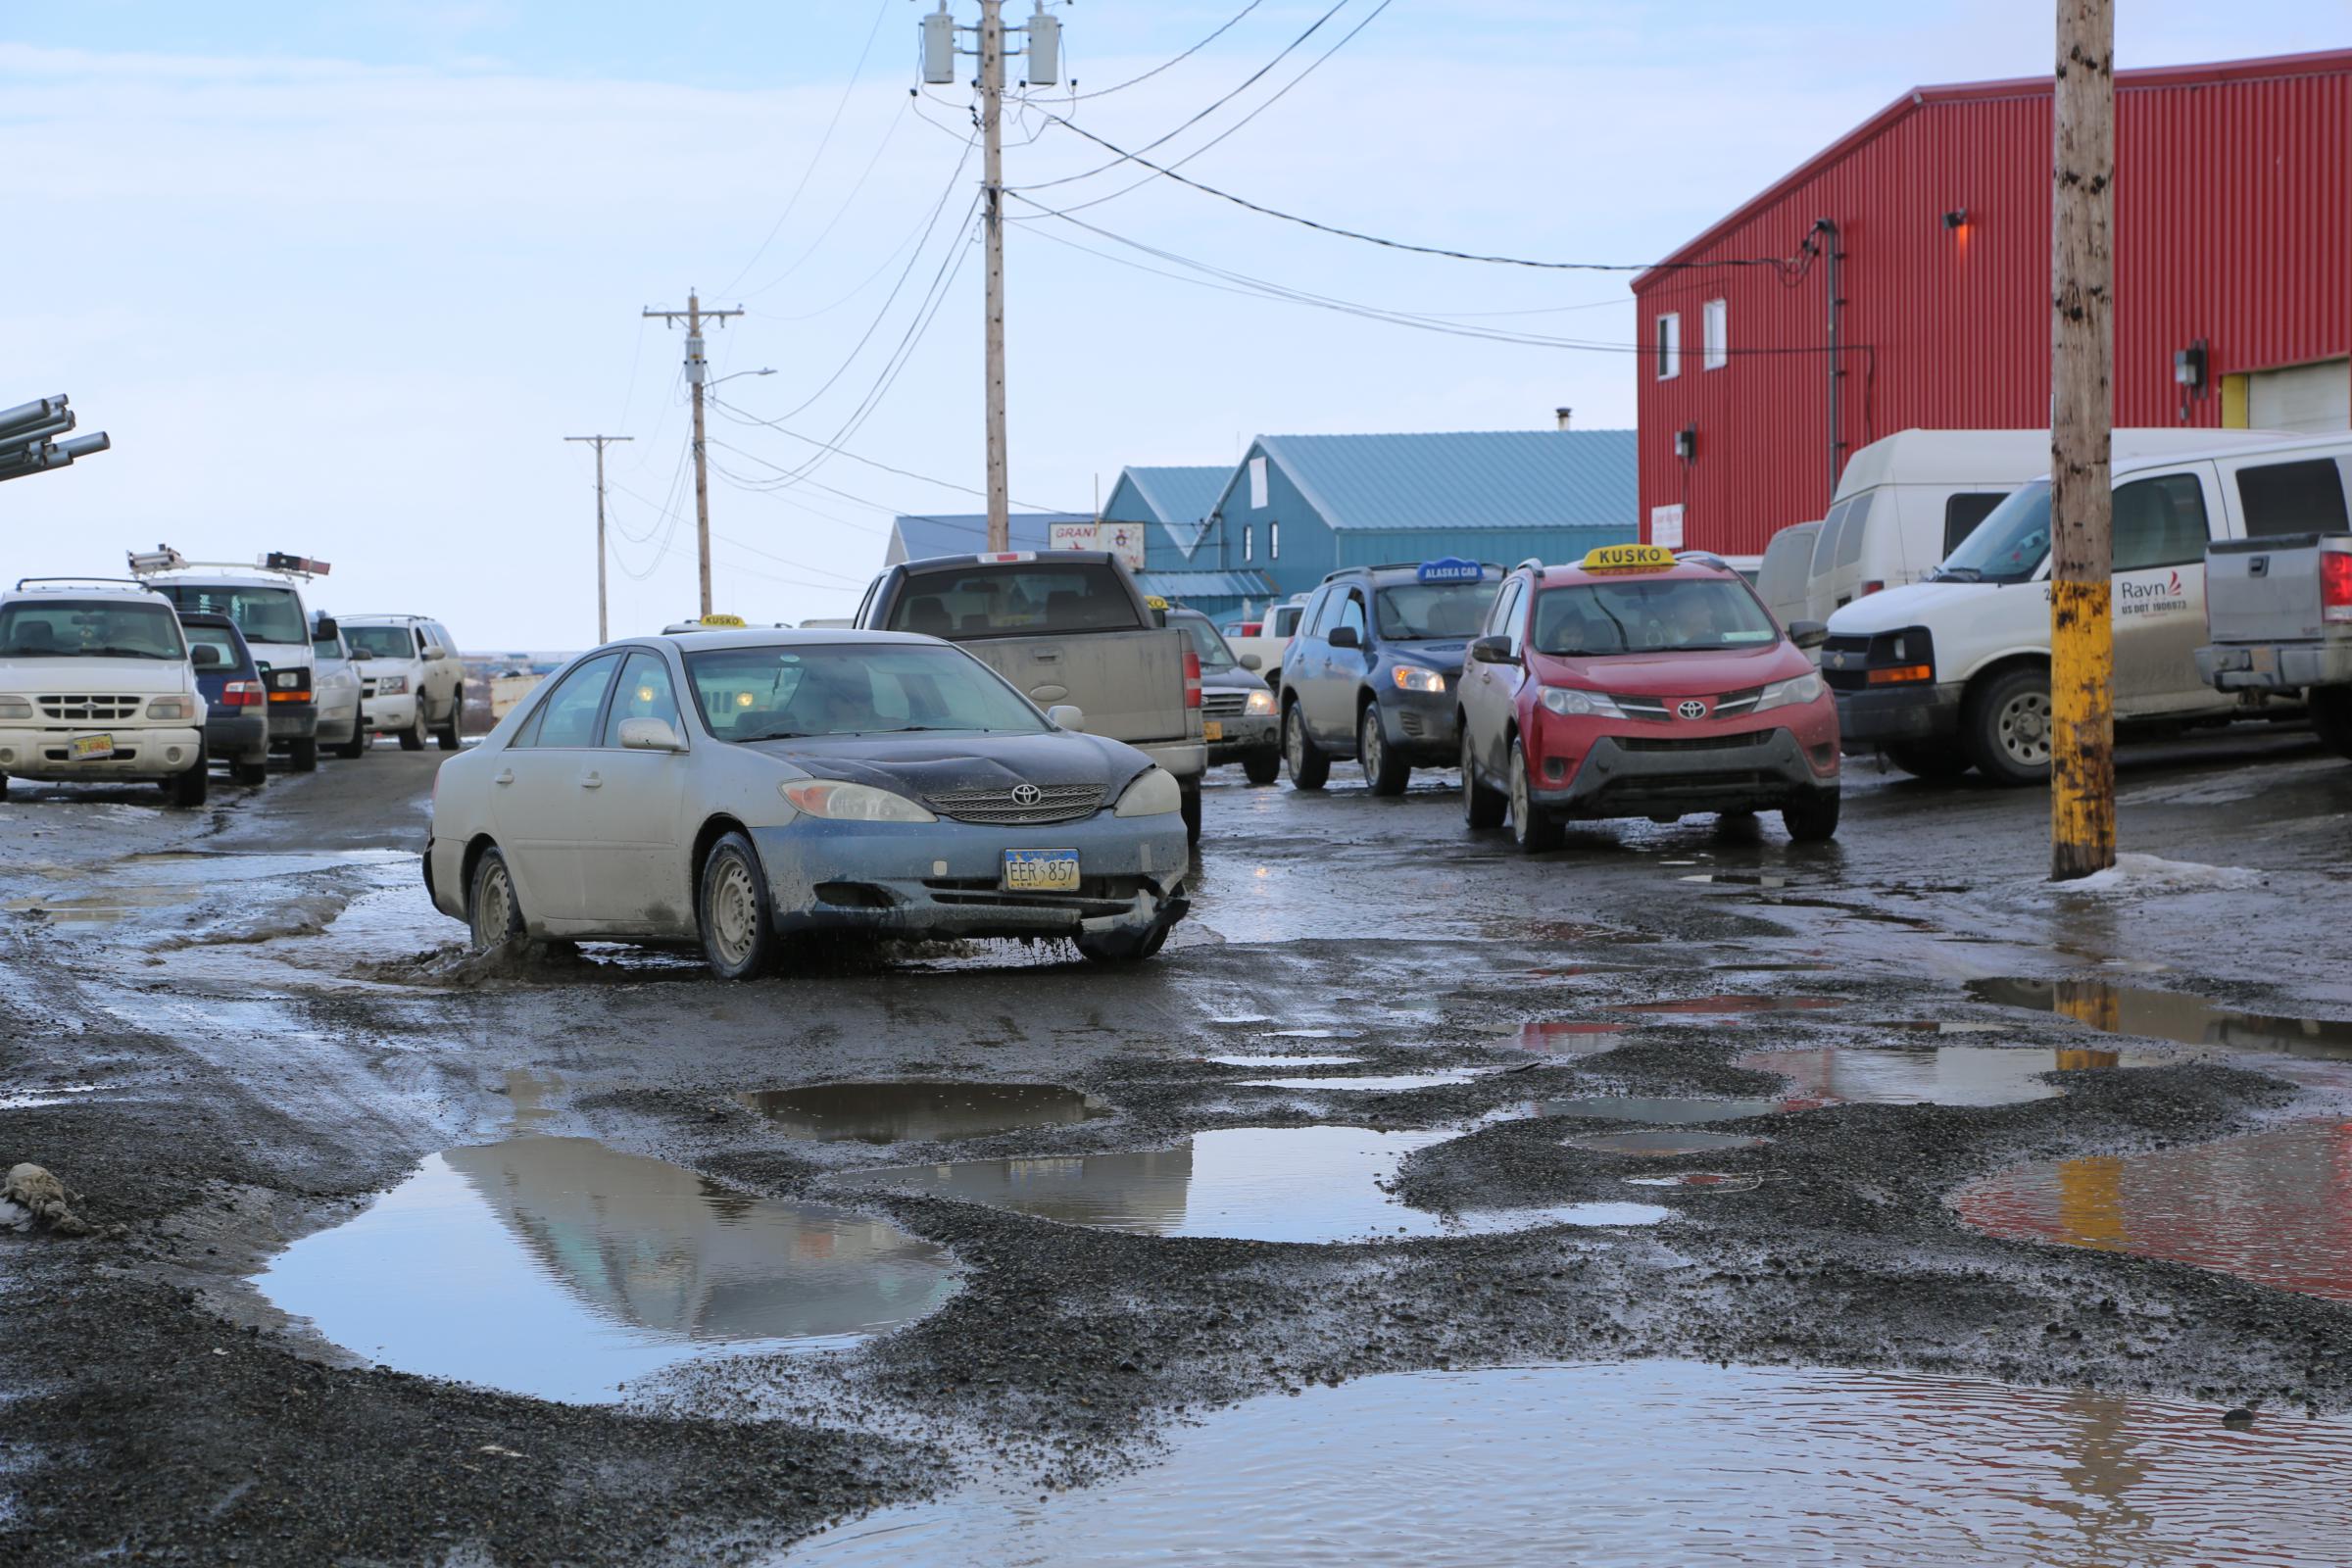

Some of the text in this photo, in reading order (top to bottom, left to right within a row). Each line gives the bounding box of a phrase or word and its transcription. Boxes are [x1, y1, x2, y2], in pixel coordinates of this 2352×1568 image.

[1599, 548, 1661, 564] KUSKO
[1425, 566, 1478, 579] ALASKA CAB
[2122, 581, 2166, 599] Ravn
[705, 616, 739, 626] KUSKO
[1010, 861, 1075, 882] EER 857
